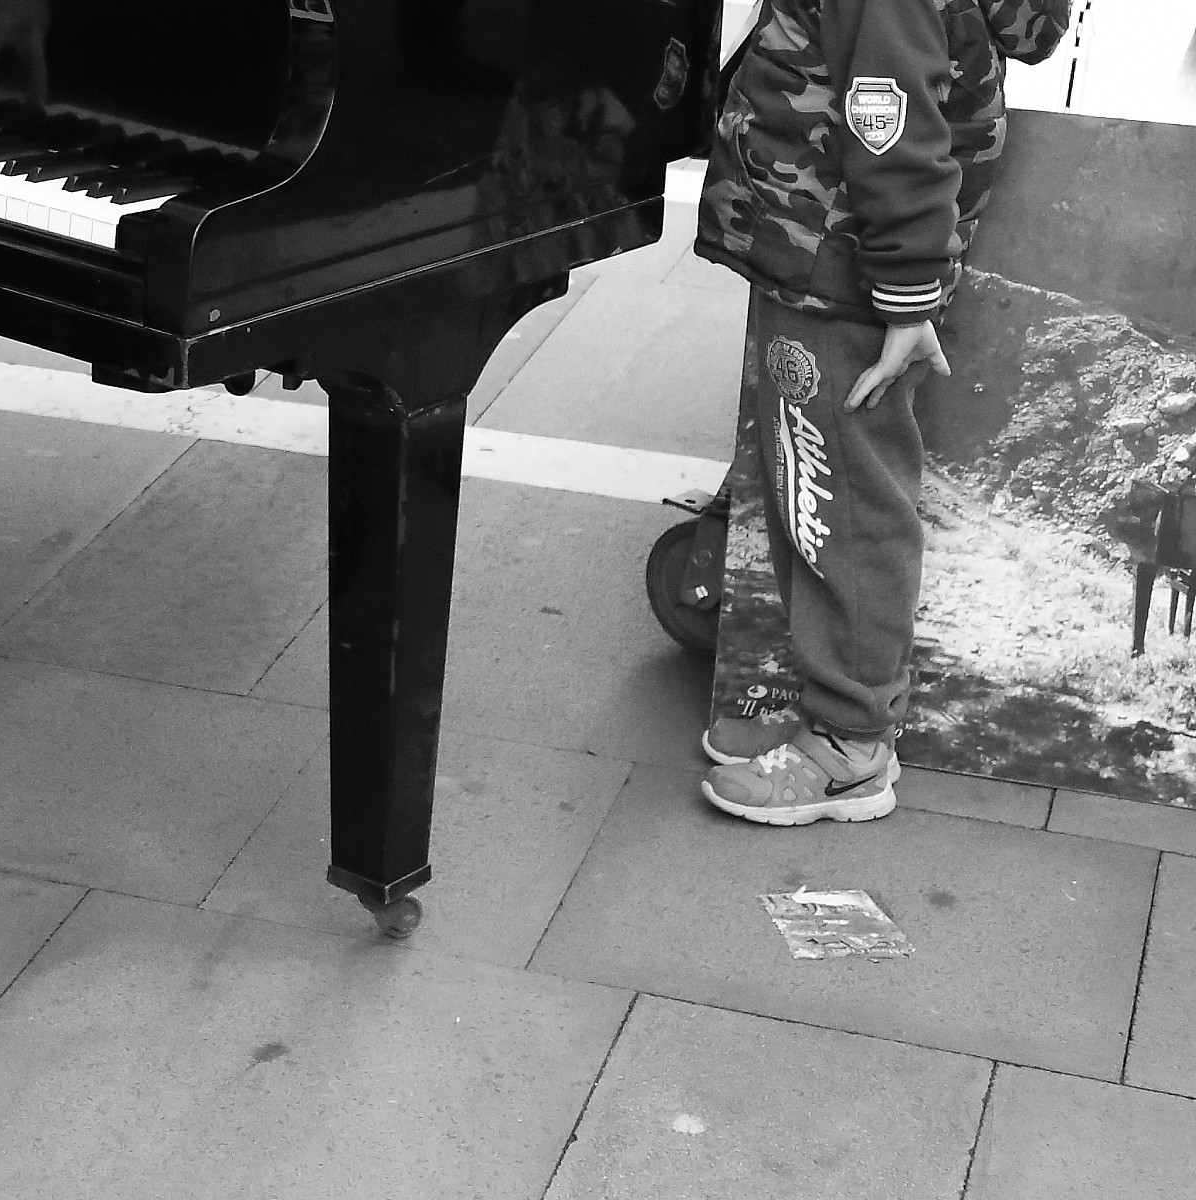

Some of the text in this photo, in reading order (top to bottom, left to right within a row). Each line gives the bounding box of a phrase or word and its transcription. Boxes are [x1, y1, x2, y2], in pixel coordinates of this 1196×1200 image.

[858, 95, 891, 105] WORLD
[788, 403, 834, 564] Athletic
[771, 687, 800, 702] PAO
